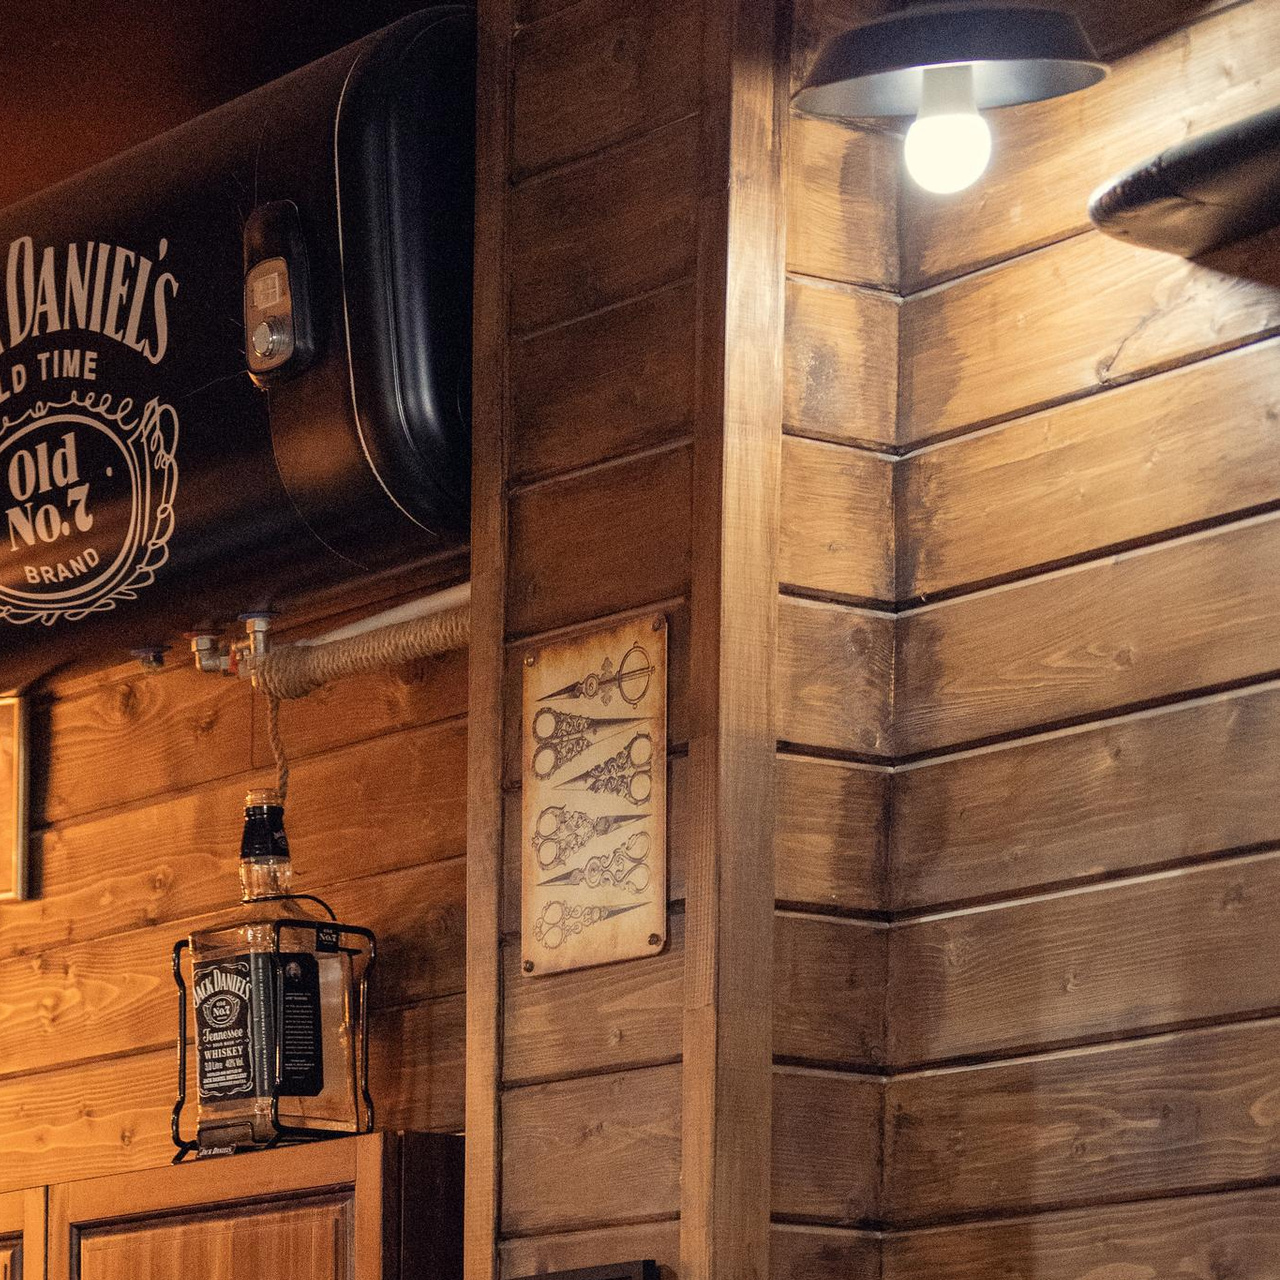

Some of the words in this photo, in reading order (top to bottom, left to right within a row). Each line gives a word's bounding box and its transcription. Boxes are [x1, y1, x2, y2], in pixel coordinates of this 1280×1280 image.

[5, 235, 180, 365] DANIEL'S
[37, 349, 99, 382] TIME
[8, 431, 80, 501] Old
[23, 547, 100, 585] BRAND
[193, 976, 214, 1008] JACK
[213, 969, 252, 1000] DANIEL'S
[202, 1028, 244, 1042] Tennessee
[204, 1045, 244, 1060] WHISKEY
